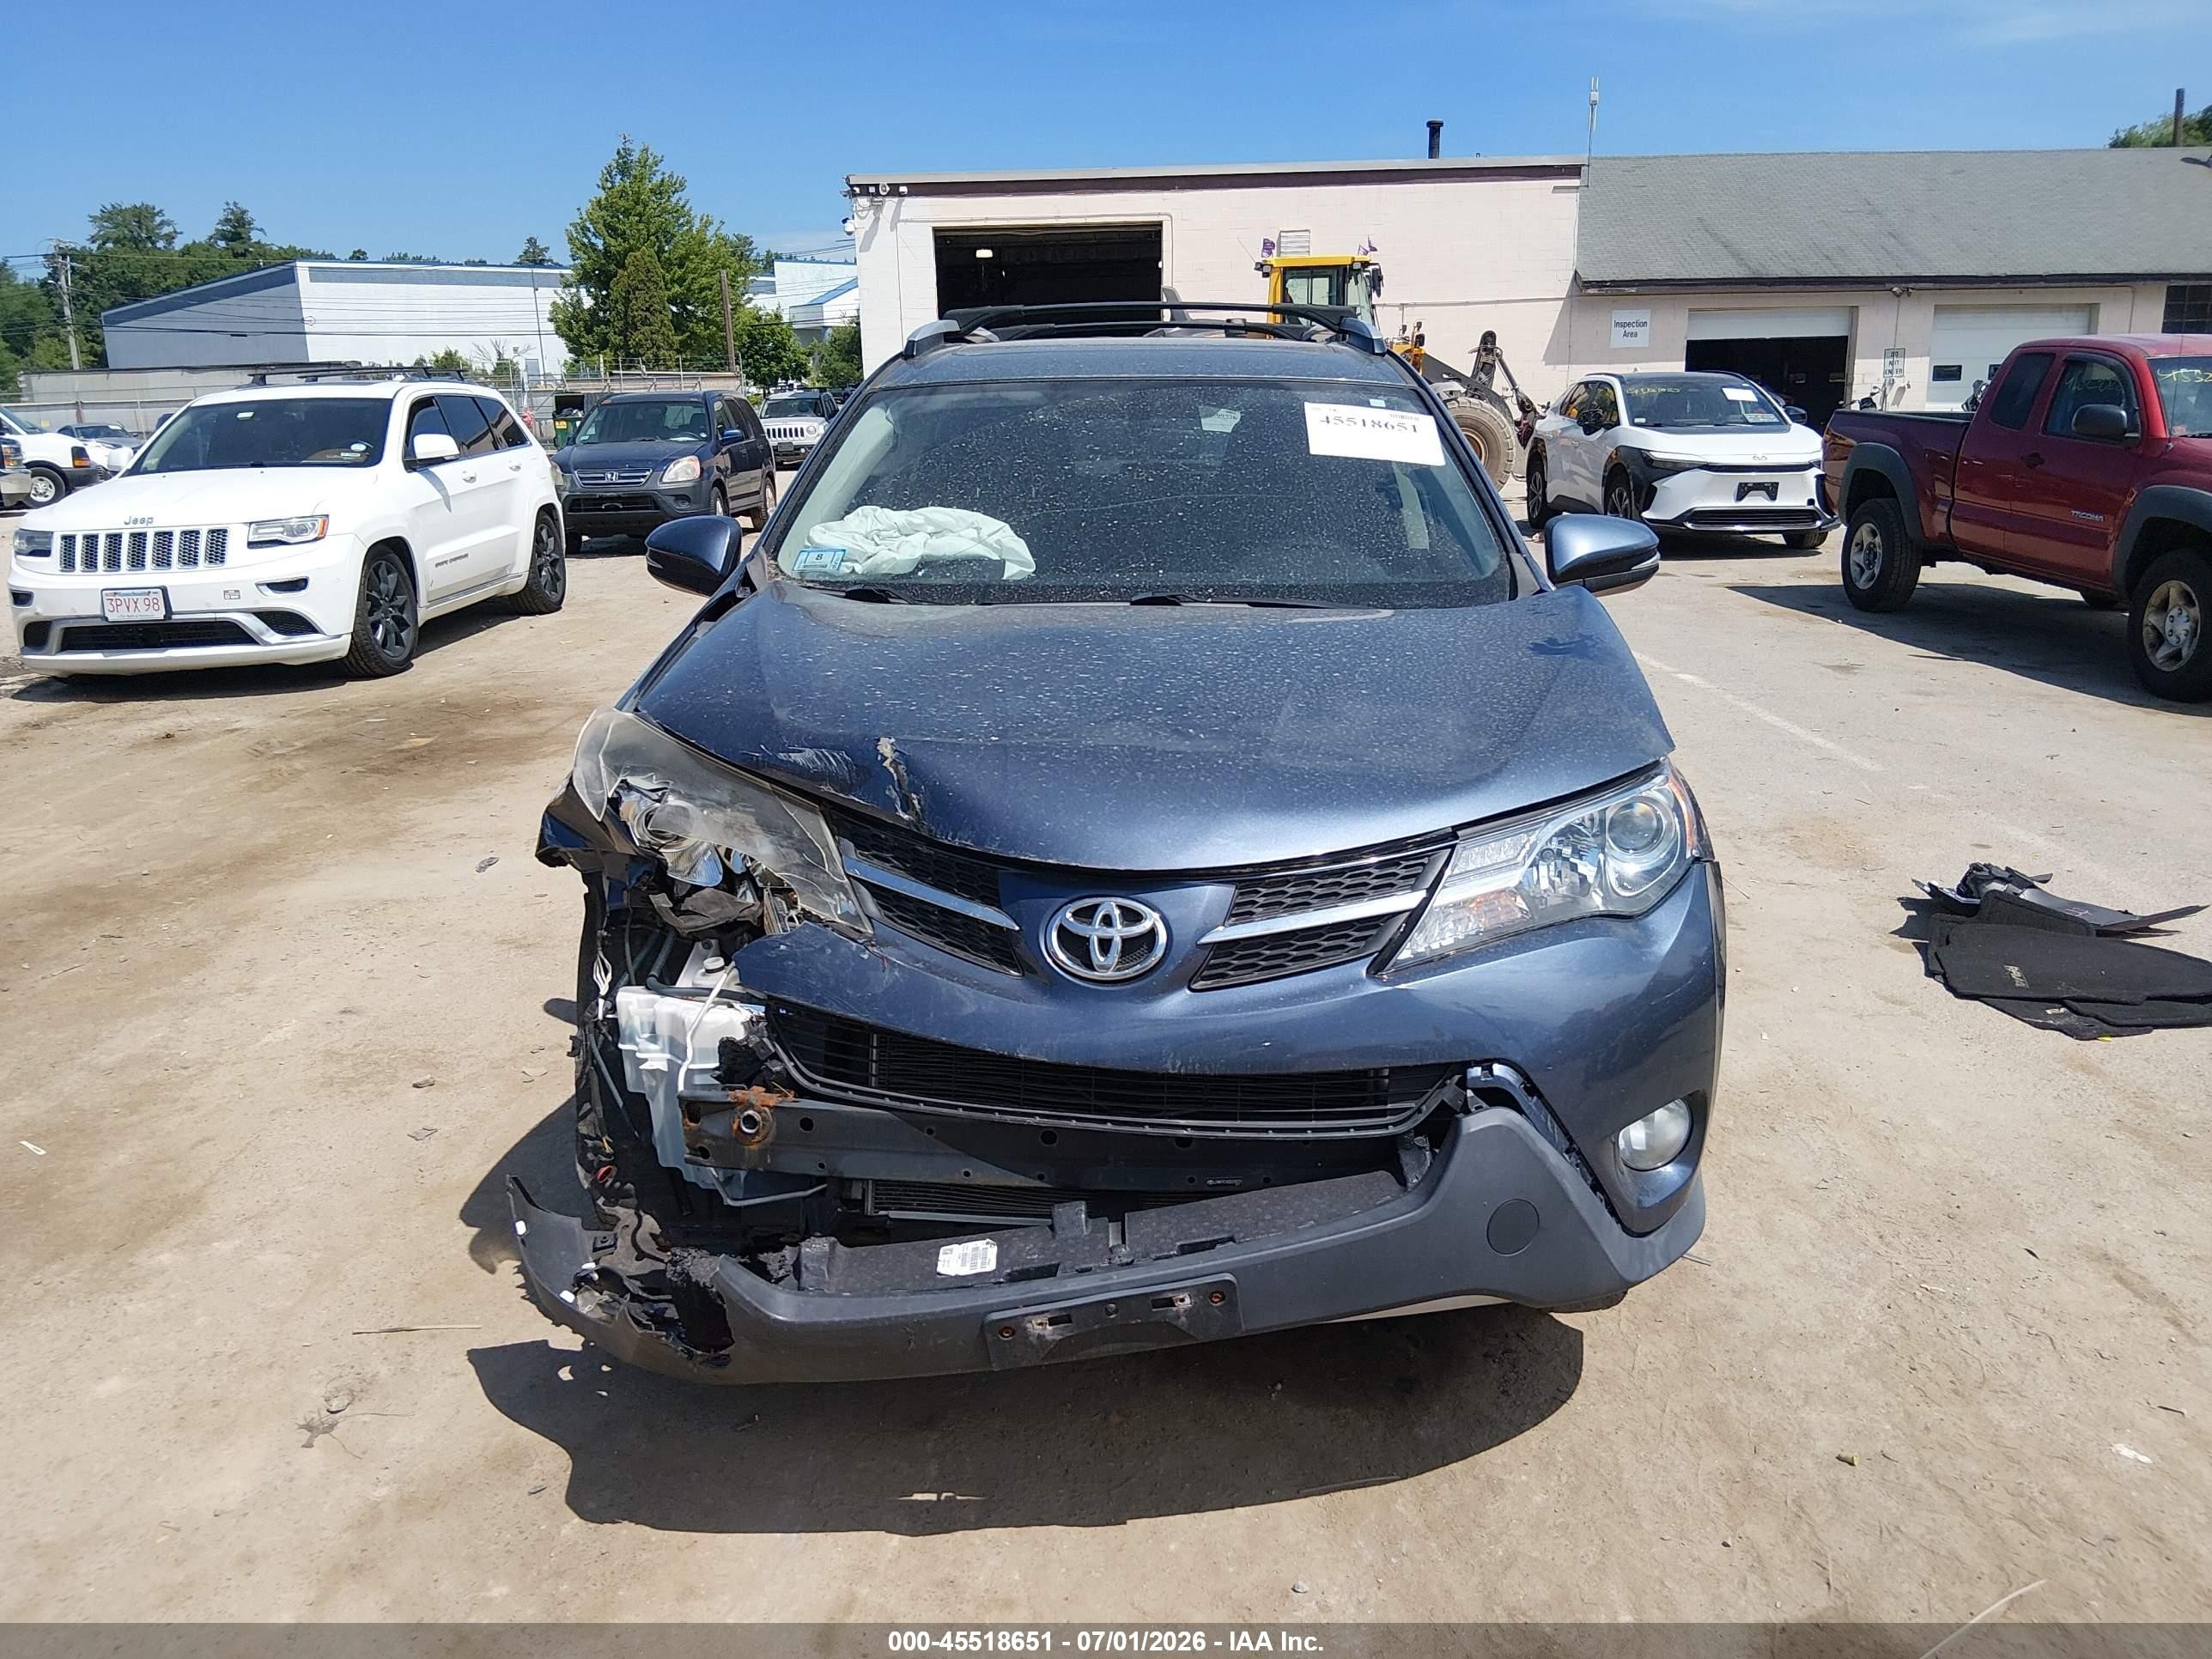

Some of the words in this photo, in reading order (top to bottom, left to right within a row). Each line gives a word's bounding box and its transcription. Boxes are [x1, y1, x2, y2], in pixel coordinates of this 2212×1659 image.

[1614, 319, 1648, 330] Inspection
[1623, 330, 1638, 338] Area
[1320, 416, 1418, 433] 45518651
[124, 515, 154, 526] Jeep
[106, 598, 141, 613] 3PVX
[143, 597, 160, 612] 98
